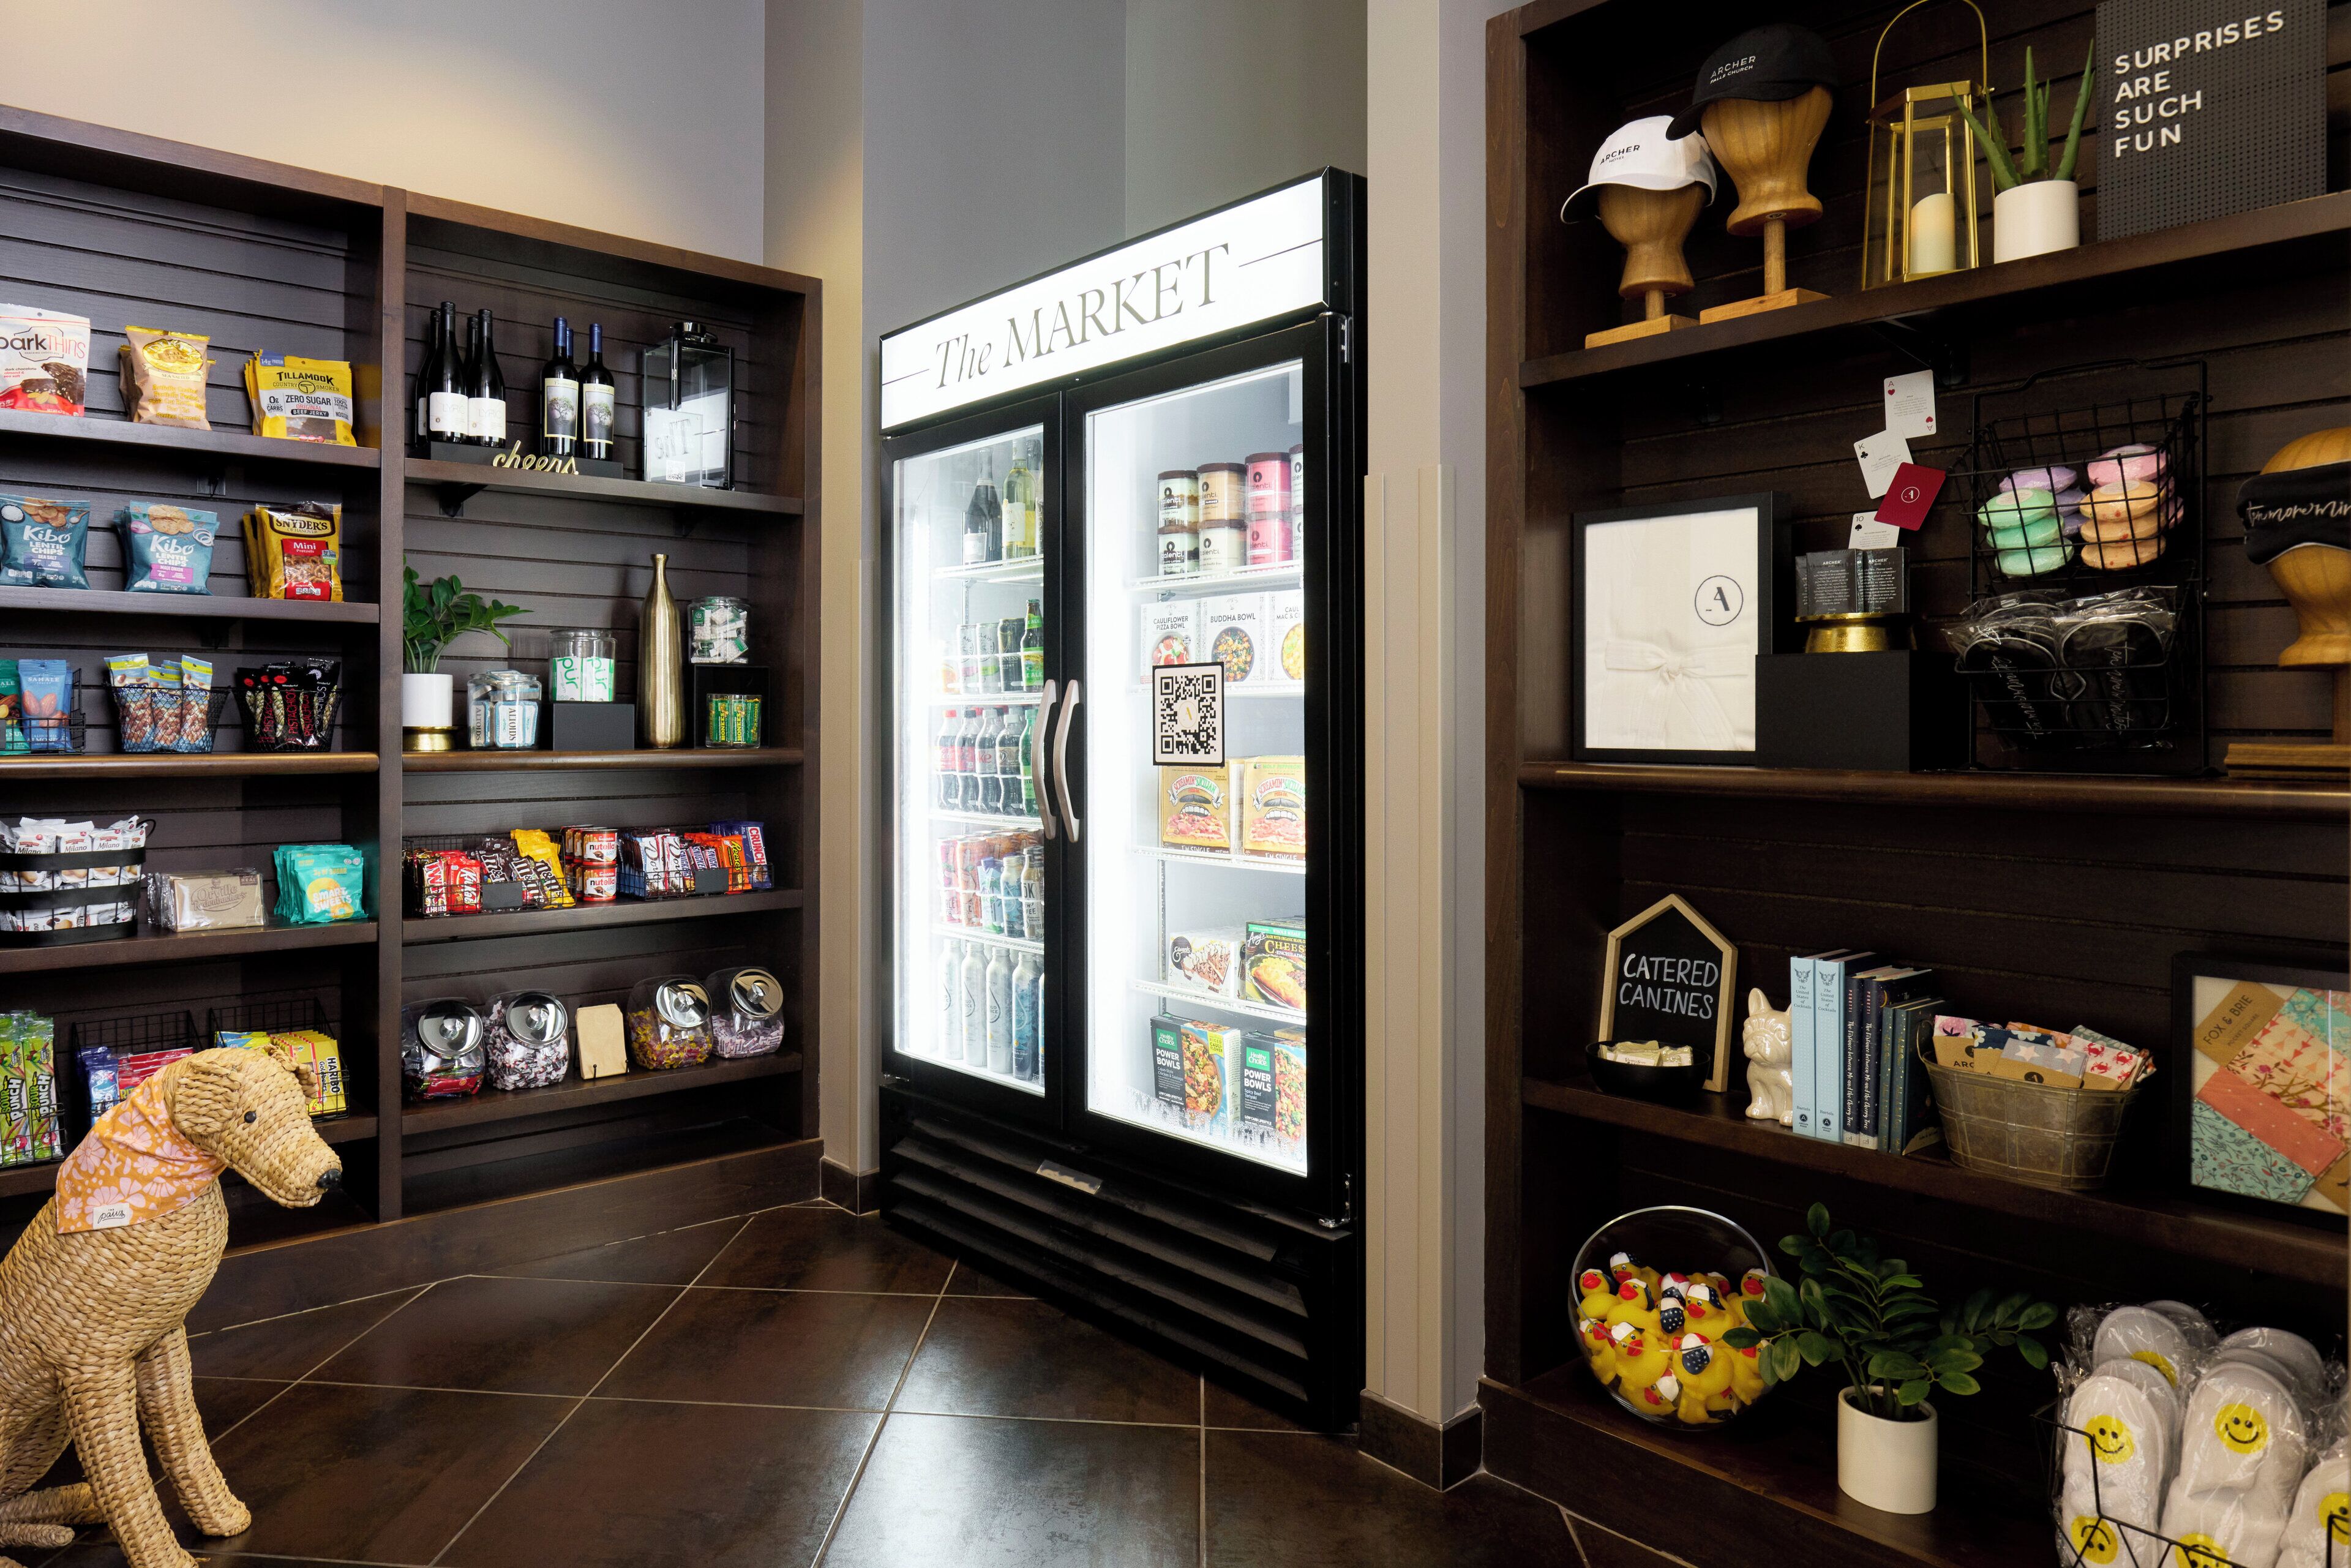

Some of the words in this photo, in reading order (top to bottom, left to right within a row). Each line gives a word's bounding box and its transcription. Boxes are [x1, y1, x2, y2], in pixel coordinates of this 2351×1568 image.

[2115, 10, 2284, 75] SURPRISES
[1710, 55, 1757, 79] ARCHER
[1710, 73, 1726, 84] FALLS
[1727, 64, 1753, 77] CHURCH
[2115, 70, 2171, 103] ARE
[2115, 90, 2202, 130] SUCH
[2115, 124, 2181, 158] FUN
[1599, 144, 1641, 165] ARCHER
[936, 336, 991, 389] The
[1002, 242, 1229, 367] MARKET
[277, 371, 334, 386] TILLAMOOK
[285, 394, 305, 403] ZERO
[306, 396, 332, 406] SUGAR
[442, 403, 465, 415] LYRIC
[478, 408, 502, 420] LYRIC
[492, 440, 579, 475] cheers
[276, 519, 328, 531] SNYDER'S
[23, 525, 73, 544] Kibo
[29, 541, 66, 550] LENTIL
[31, 547, 64, 555] CHIPS
[150, 534, 196, 556] Kibo
[156, 552, 189, 562] LENTIL
[157, 558, 187, 567] CHIPS
[1153, 615, 1188, 625] CAULIFLOWER
[1210, 614, 1237, 623] BUDDHA
[508, 708, 517, 741] ALTOIDS
[589, 842, 615, 850] nutella
[749, 827, 765, 865] CRUNCH
[590, 877, 615, 886] nutella
[197, 884, 238, 901] Orville
[313, 887, 348, 902] SMART
[313, 895, 352, 913] SWEETS
[1247, 931, 1266, 947] Amy's
[1264, 940, 1305, 954] CHEES
[1623, 953, 1719, 988] CATERED
[1619, 982, 1714, 1019] CANINES
[2203, 1022, 2226, 1046] FOX
[2224, 1015, 2233, 1026] &
[2231, 994, 2253, 1018] BRIE
[1158, 1038, 1176, 1047] Choice
[1160, 1032, 1174, 1041] Healthy
[1156, 1048, 1179, 1061] POWER
[1248, 1056, 1267, 1067] Choice
[1250, 1051, 1267, 1060] Healthy
[1157, 1057, 1181, 1070] BOWLS
[327, 1056, 341, 1094] HARIBO
[1244, 1069, 1271, 1082] POWER
[1244, 1078, 1272, 1093] BOWLS
[0, 1088, 10, 1114] SOUR
[10, 1077, 24, 1122] PUNCH
[31, 1084, 39, 1109] SOUR
[39, 1073, 53, 1117] PUNCH
